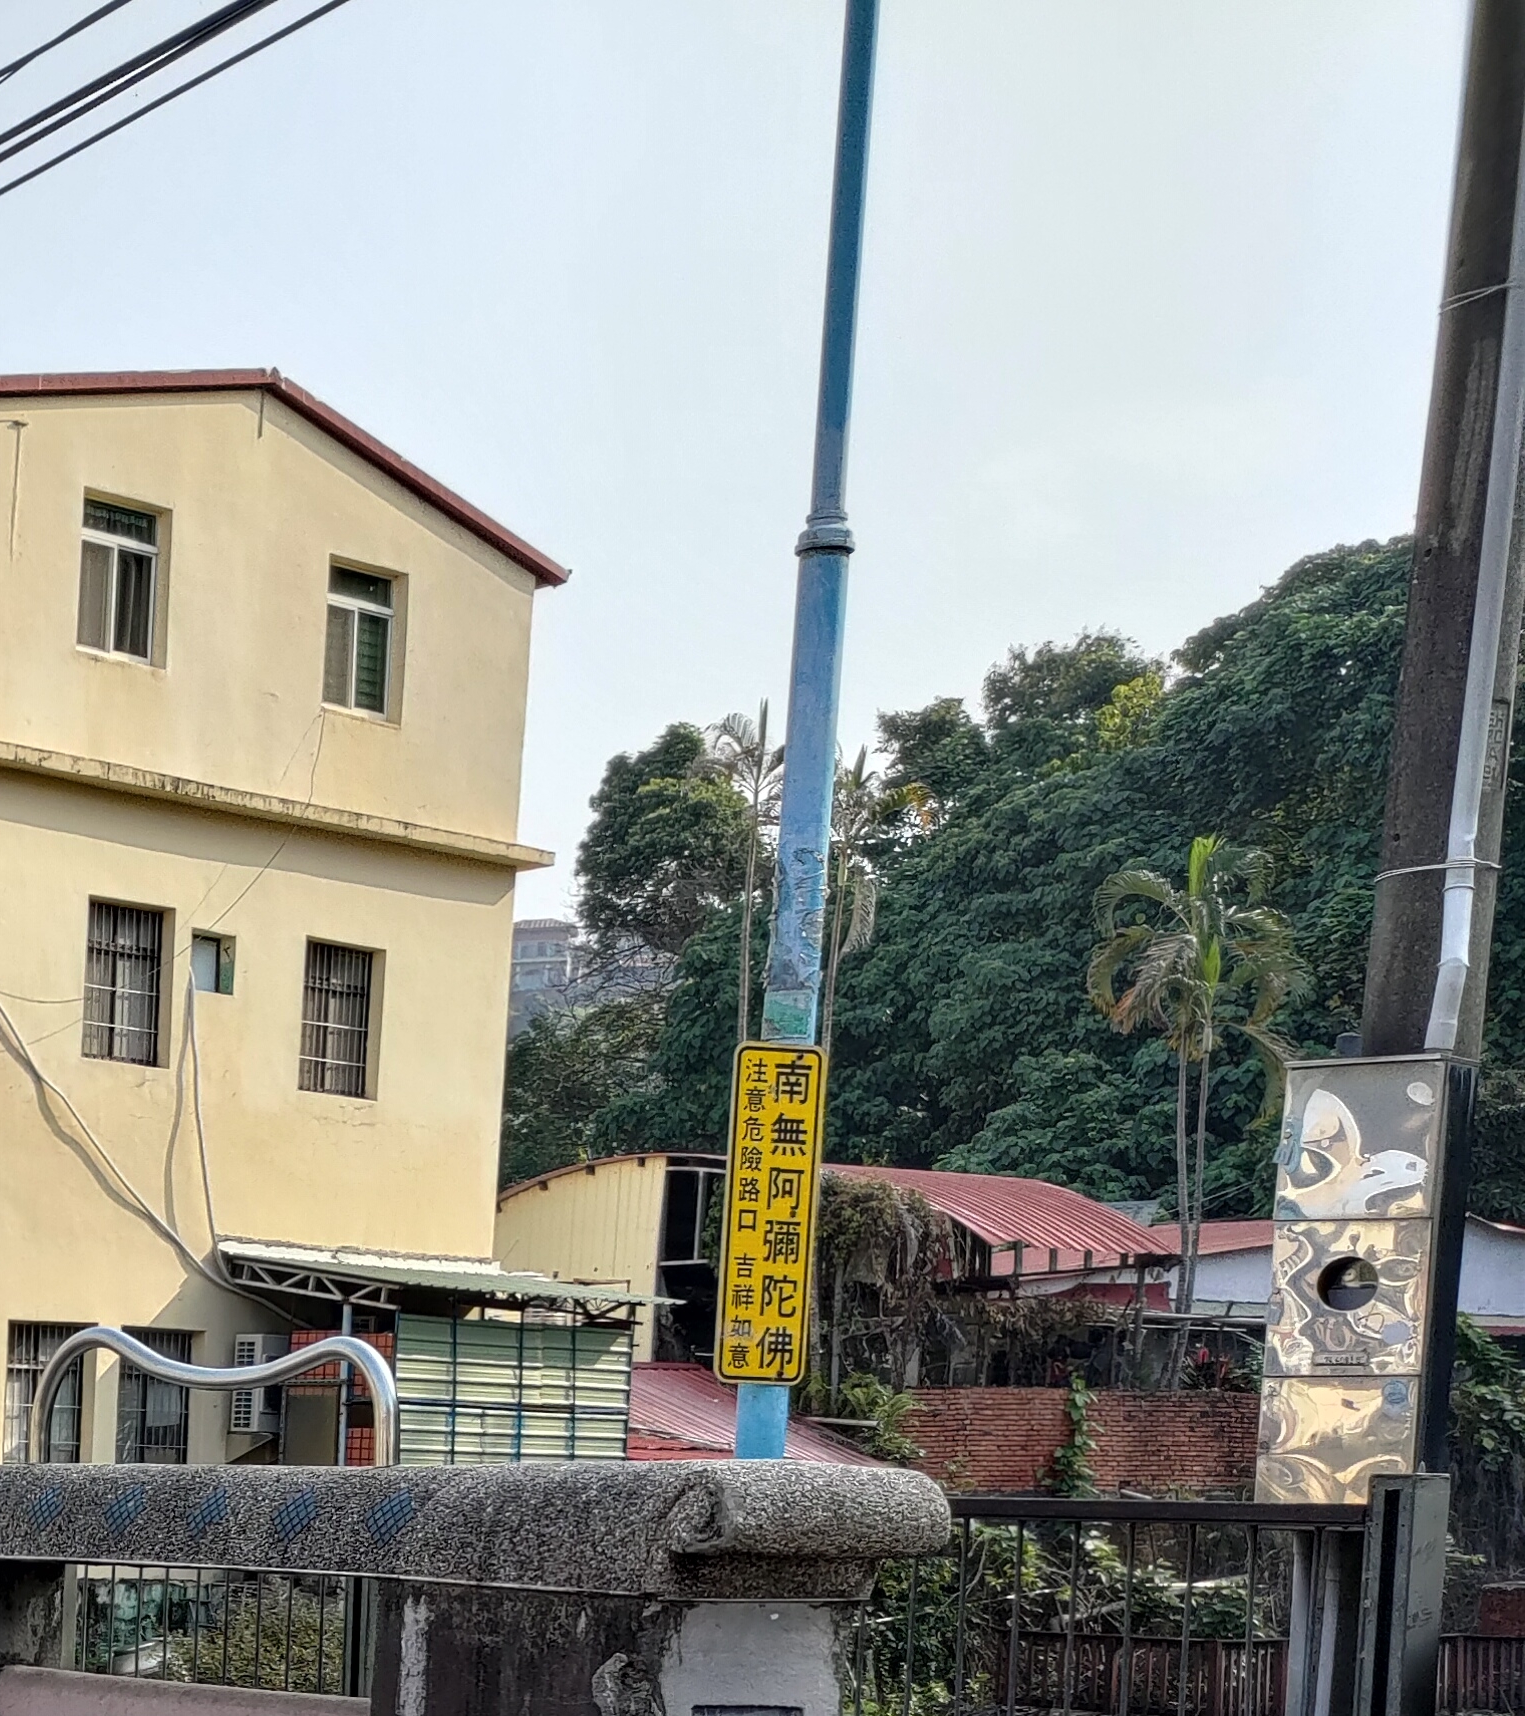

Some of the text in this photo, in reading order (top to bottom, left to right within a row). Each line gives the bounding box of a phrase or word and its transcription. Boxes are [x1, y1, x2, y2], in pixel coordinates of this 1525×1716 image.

[736, 1057, 769, 1232] 注意危險路口
[755, 1055, 813, 1373] 南無阿彌陀佛
[727, 1252, 757, 1370] 吉祥如意
